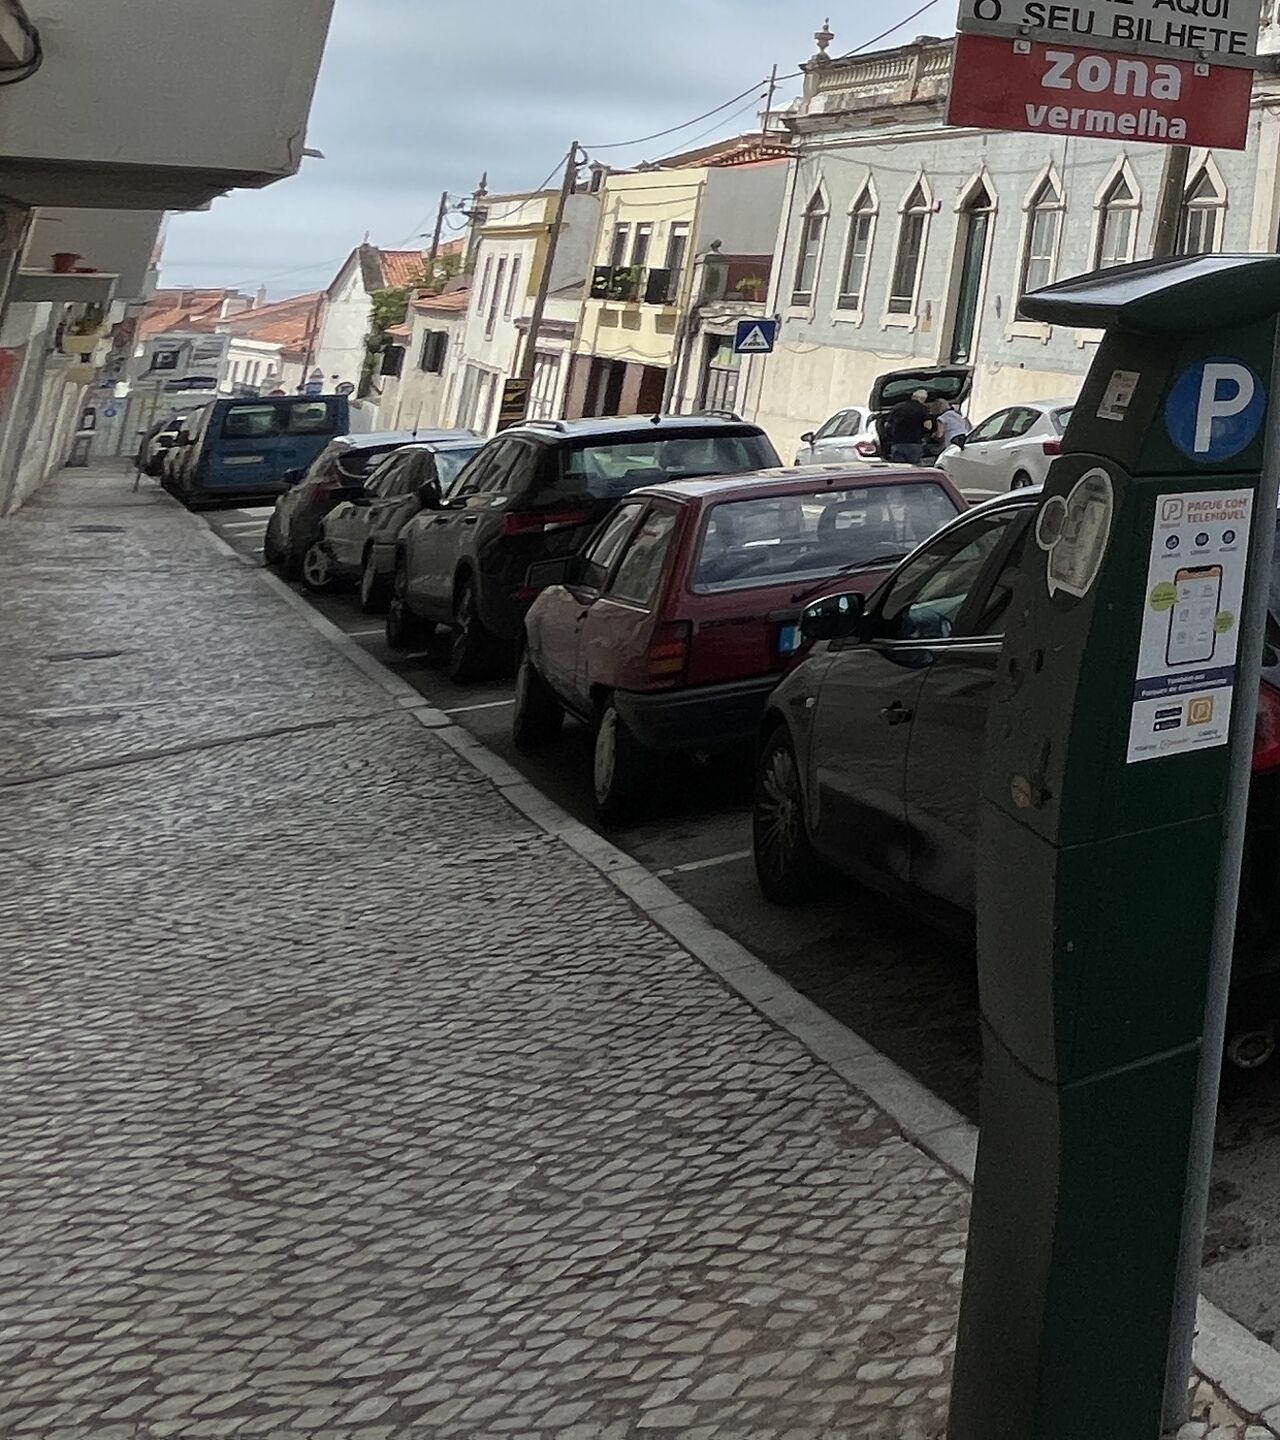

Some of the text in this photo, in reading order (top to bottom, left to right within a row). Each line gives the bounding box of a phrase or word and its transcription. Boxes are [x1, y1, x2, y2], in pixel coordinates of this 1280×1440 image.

[1023, 2, 1095, 35] SEU
[1112, 17, 1249, 56] BILHETE
[1040, 50, 1182, 101] zona
[1025, 101, 1188, 140] vermelha
[1194, 362, 1255, 454] P
[1187, 498, 1248, 512] PAGUE COM
[1187, 509, 1246, 523] TELEMÓVEL
